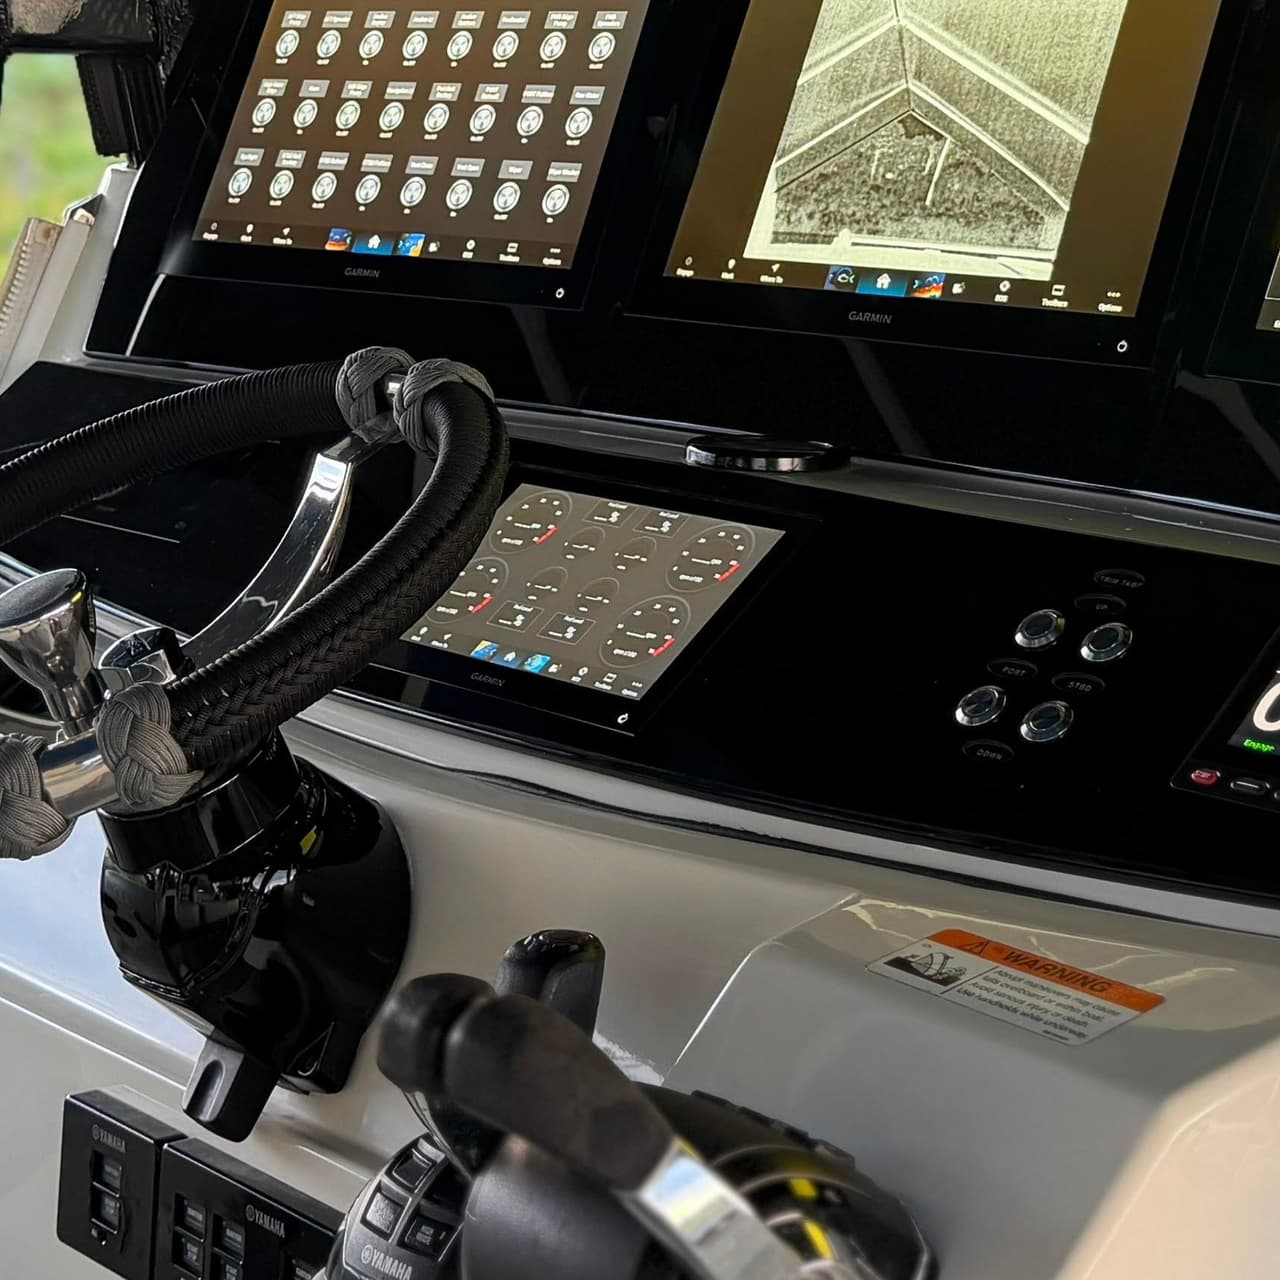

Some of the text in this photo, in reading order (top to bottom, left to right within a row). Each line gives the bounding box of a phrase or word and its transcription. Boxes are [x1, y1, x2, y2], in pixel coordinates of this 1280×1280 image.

[344, 267, 381, 278] GARMIN
[848, 311, 892, 324] GARMIN
[976, 748, 1003, 761] DOWN
[1243, 739, 1275, 753] Engage
[1003, 951, 1113, 994] WARNING
[100, 1127, 126, 1153] YAMAHA
[255, 1207, 286, 1239] YAMAHA
[371, 1248, 413, 1280] YAMAHA
